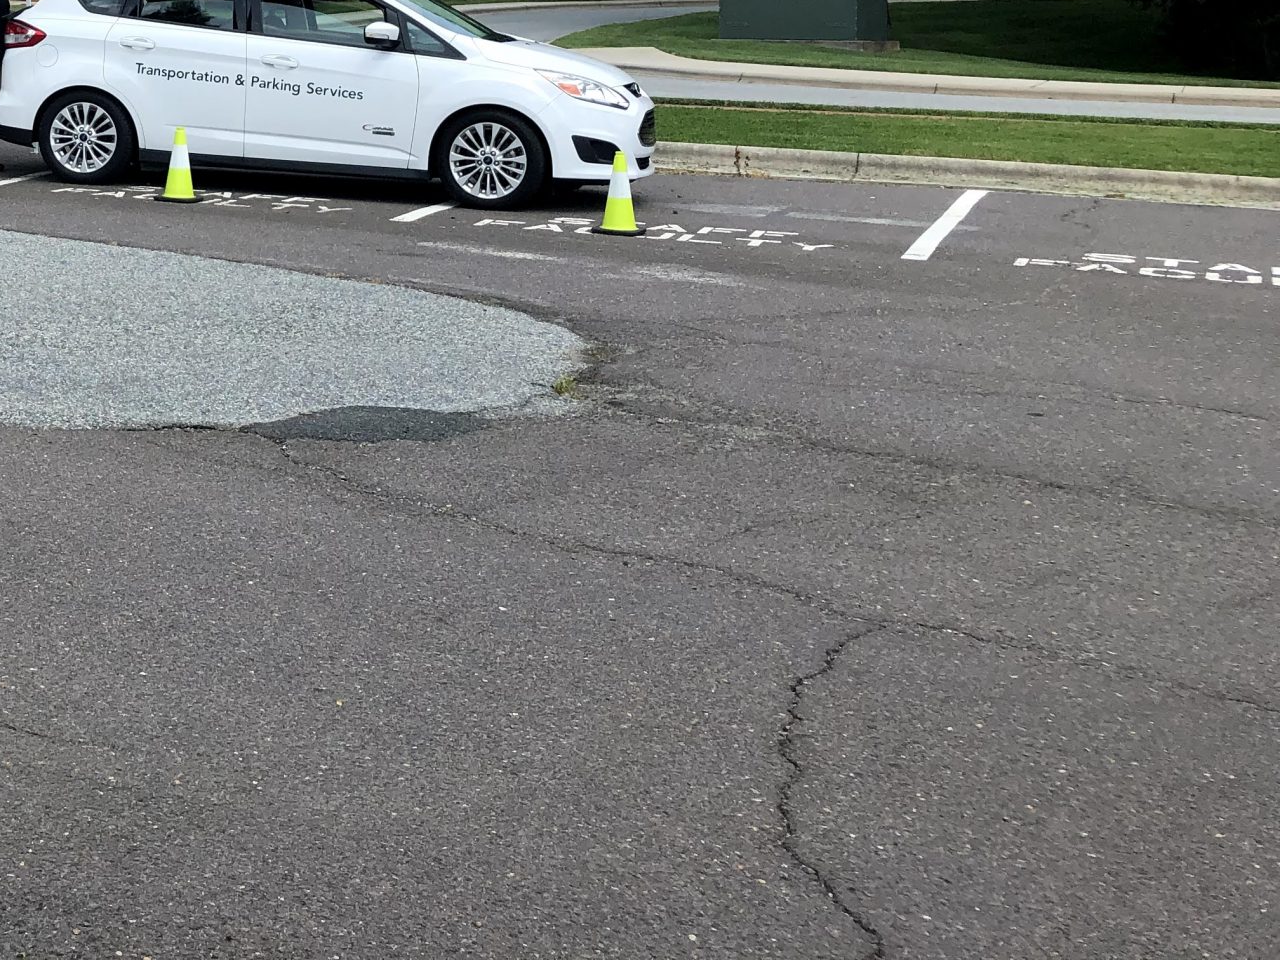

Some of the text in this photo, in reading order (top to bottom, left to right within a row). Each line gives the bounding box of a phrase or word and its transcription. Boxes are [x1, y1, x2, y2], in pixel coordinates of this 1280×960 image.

[136, 62, 364, 100] Transportation & Parking Services
[122, 185, 332, 202] SAFF
[547, 217, 799, 238] SAFF
[1013, 257, 1280, 287] FACU
